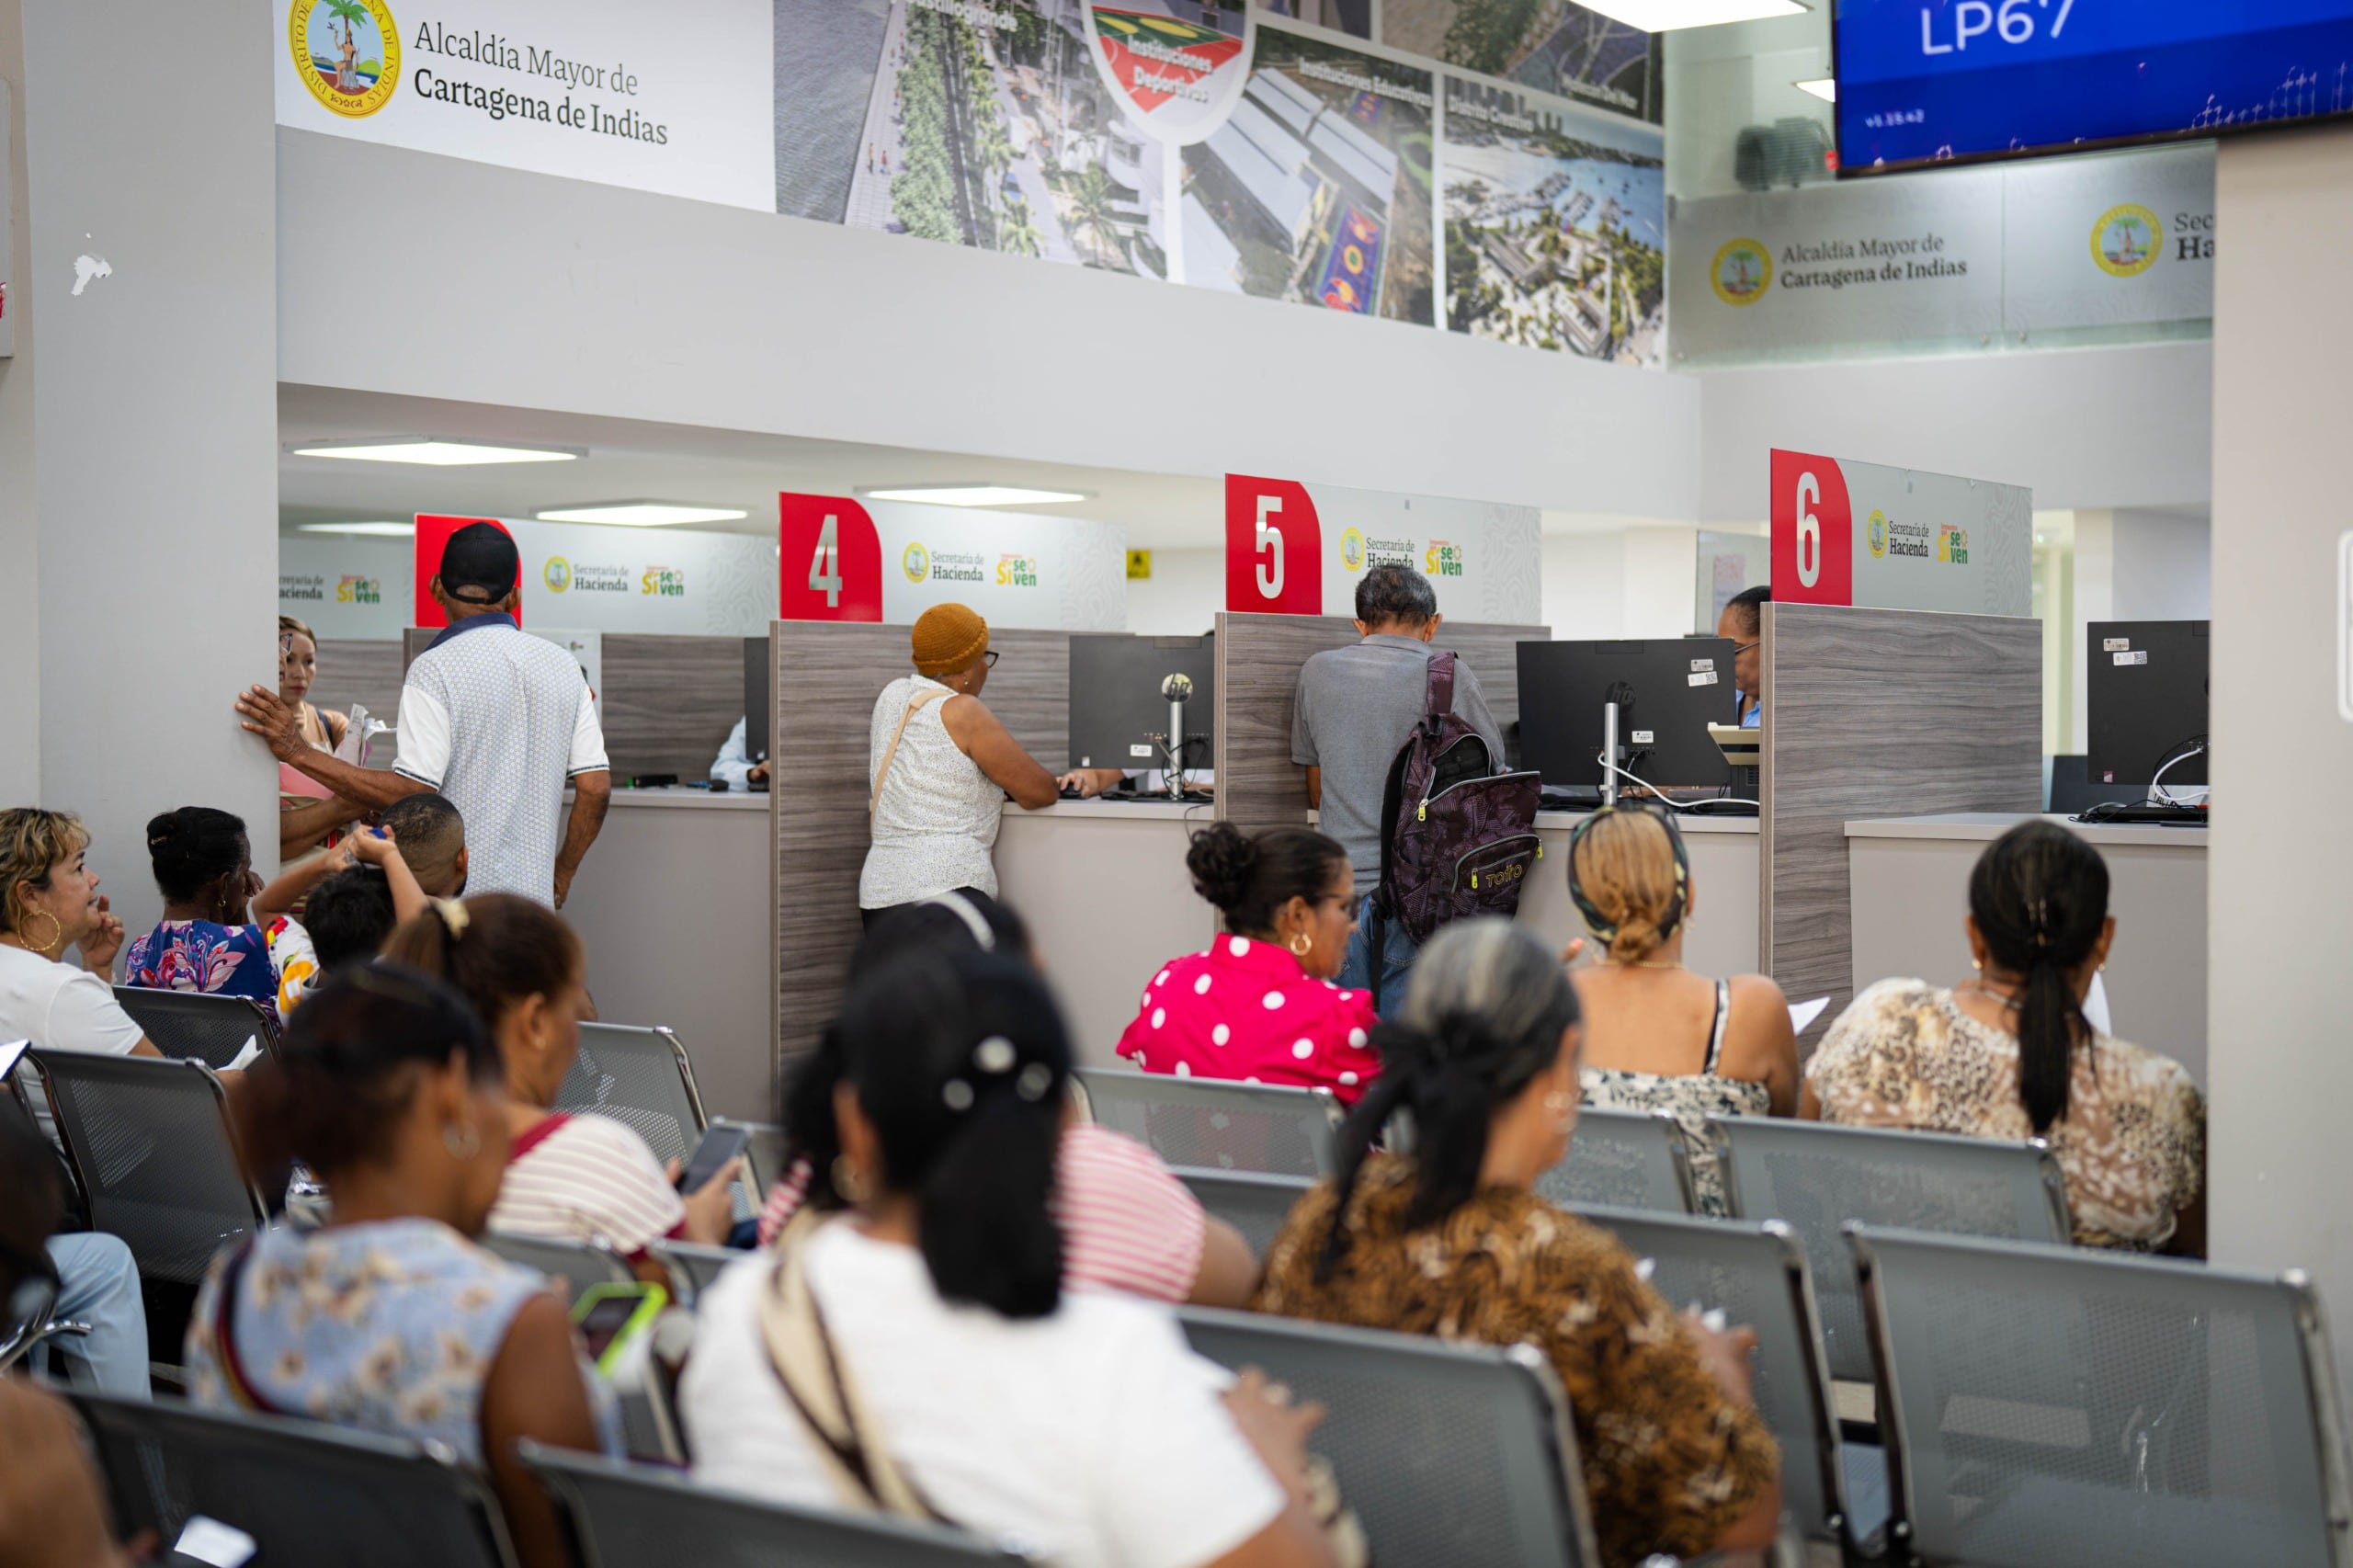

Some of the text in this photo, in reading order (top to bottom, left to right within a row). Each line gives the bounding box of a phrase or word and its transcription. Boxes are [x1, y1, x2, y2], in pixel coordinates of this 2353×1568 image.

[295, 24, 327, 96] DISTRITO
[414, 21, 638, 96] Alcaldía Mayor de
[368, 55, 396, 105] INDIAS
[414, 68, 668, 145] Cartagena de Indias
[1859, 237, 1917, 263] Mayor
[1921, 233, 1945, 253] de
[1780, 257, 1969, 290] Cartagena de Indias
[1796, 471, 1821, 588] 6
[1889, 520, 1921, 537] Secretaría
[1921, 522, 1929, 538] de
[1256, 494, 1285, 599] 5
[1405, 539, 1415, 552] de
[1949, 531, 1960, 547] se
[1440, 546, 1452, 560] se
[1889, 538, 1928, 557] Hacienda
[1949, 547, 1968, 564] ven
[808, 514, 843, 608] 4
[974, 552, 984, 565] de
[1013, 559, 1027, 572] se
[932, 565, 983, 581] Hacienda
[1441, 561, 1462, 576] ven
[574, 576, 629, 592] Hacienda
[659, 571, 673, 583] se
[1013, 573, 1037, 586] ven
[278, 586, 323, 600] acienda
[355, 580, 369, 591] se
[659, 584, 684, 597] ven
[355, 591, 381, 604] ven
